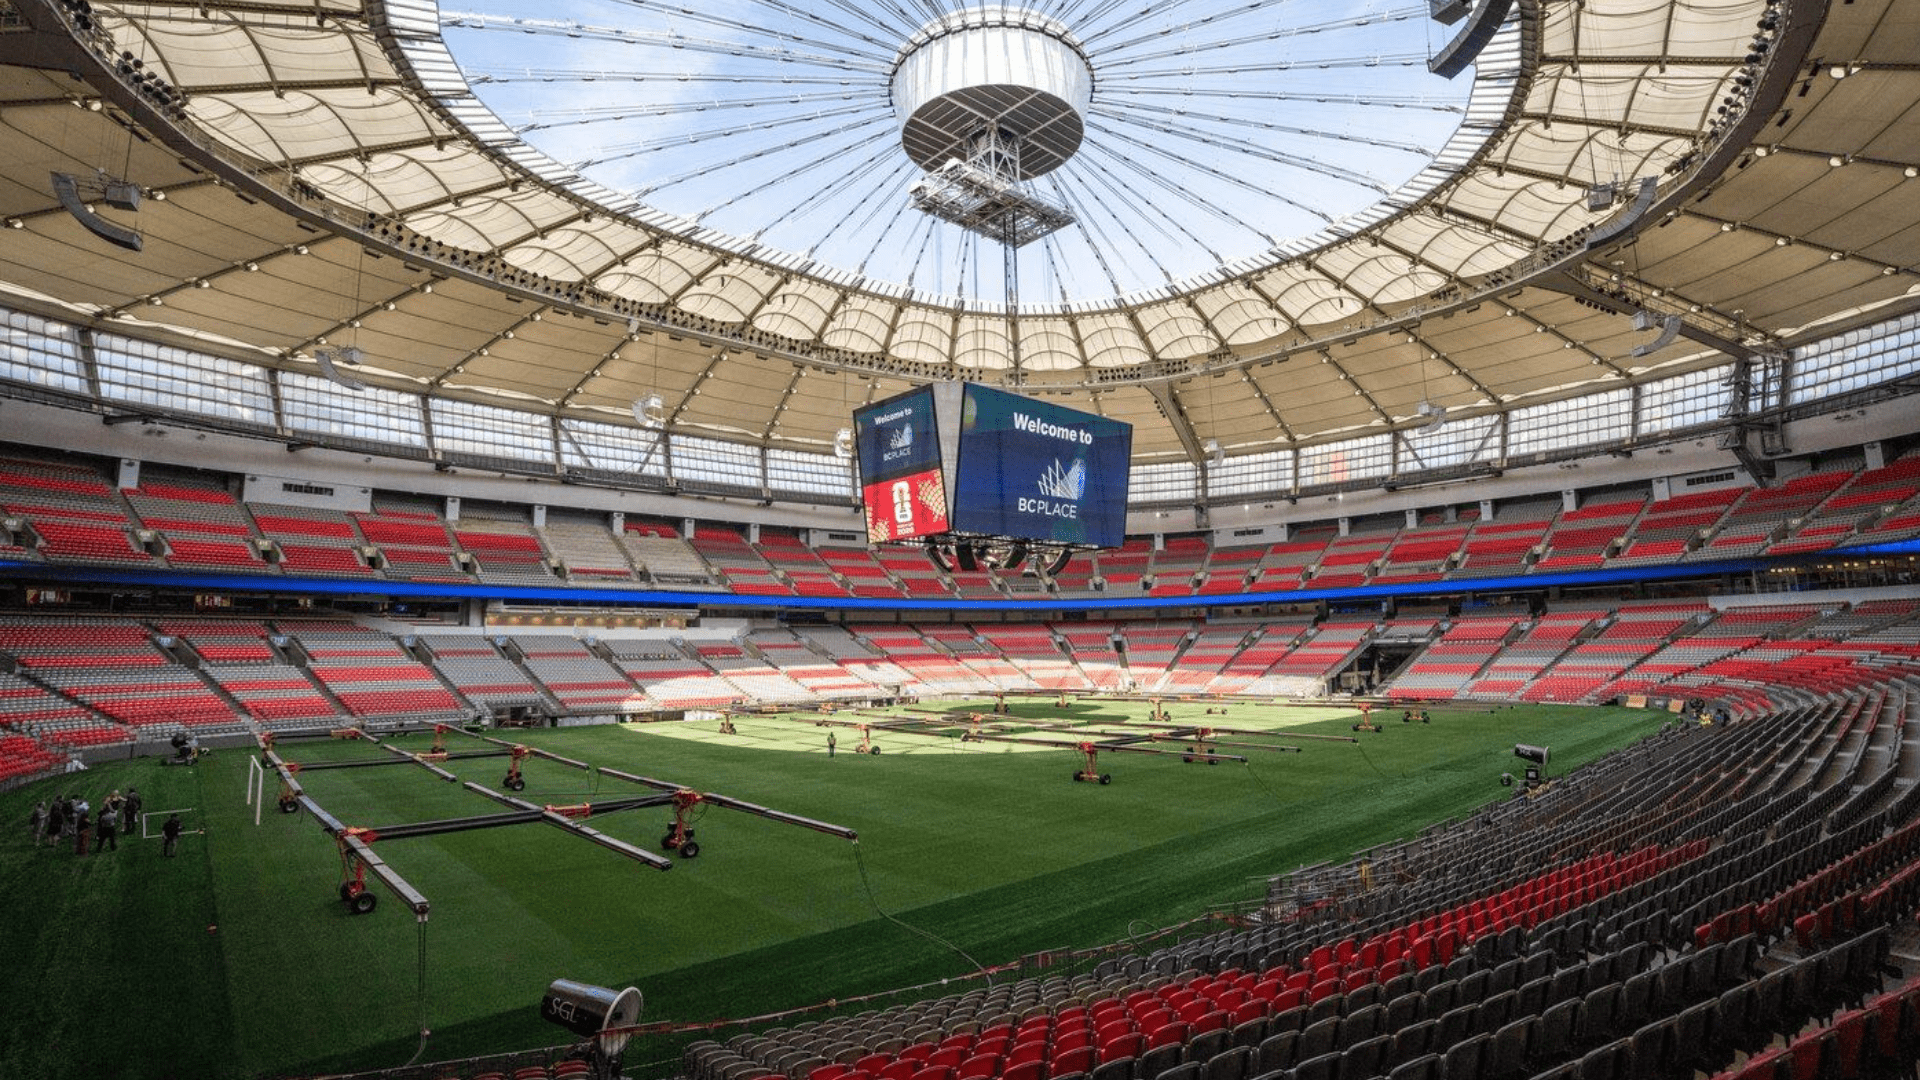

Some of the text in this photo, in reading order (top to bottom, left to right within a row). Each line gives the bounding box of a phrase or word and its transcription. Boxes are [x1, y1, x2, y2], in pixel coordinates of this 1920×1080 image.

[874, 410, 904, 425] Welcome
[1013, 412, 1093, 445] Welcome to
[549, 997, 577, 1023] SGL
